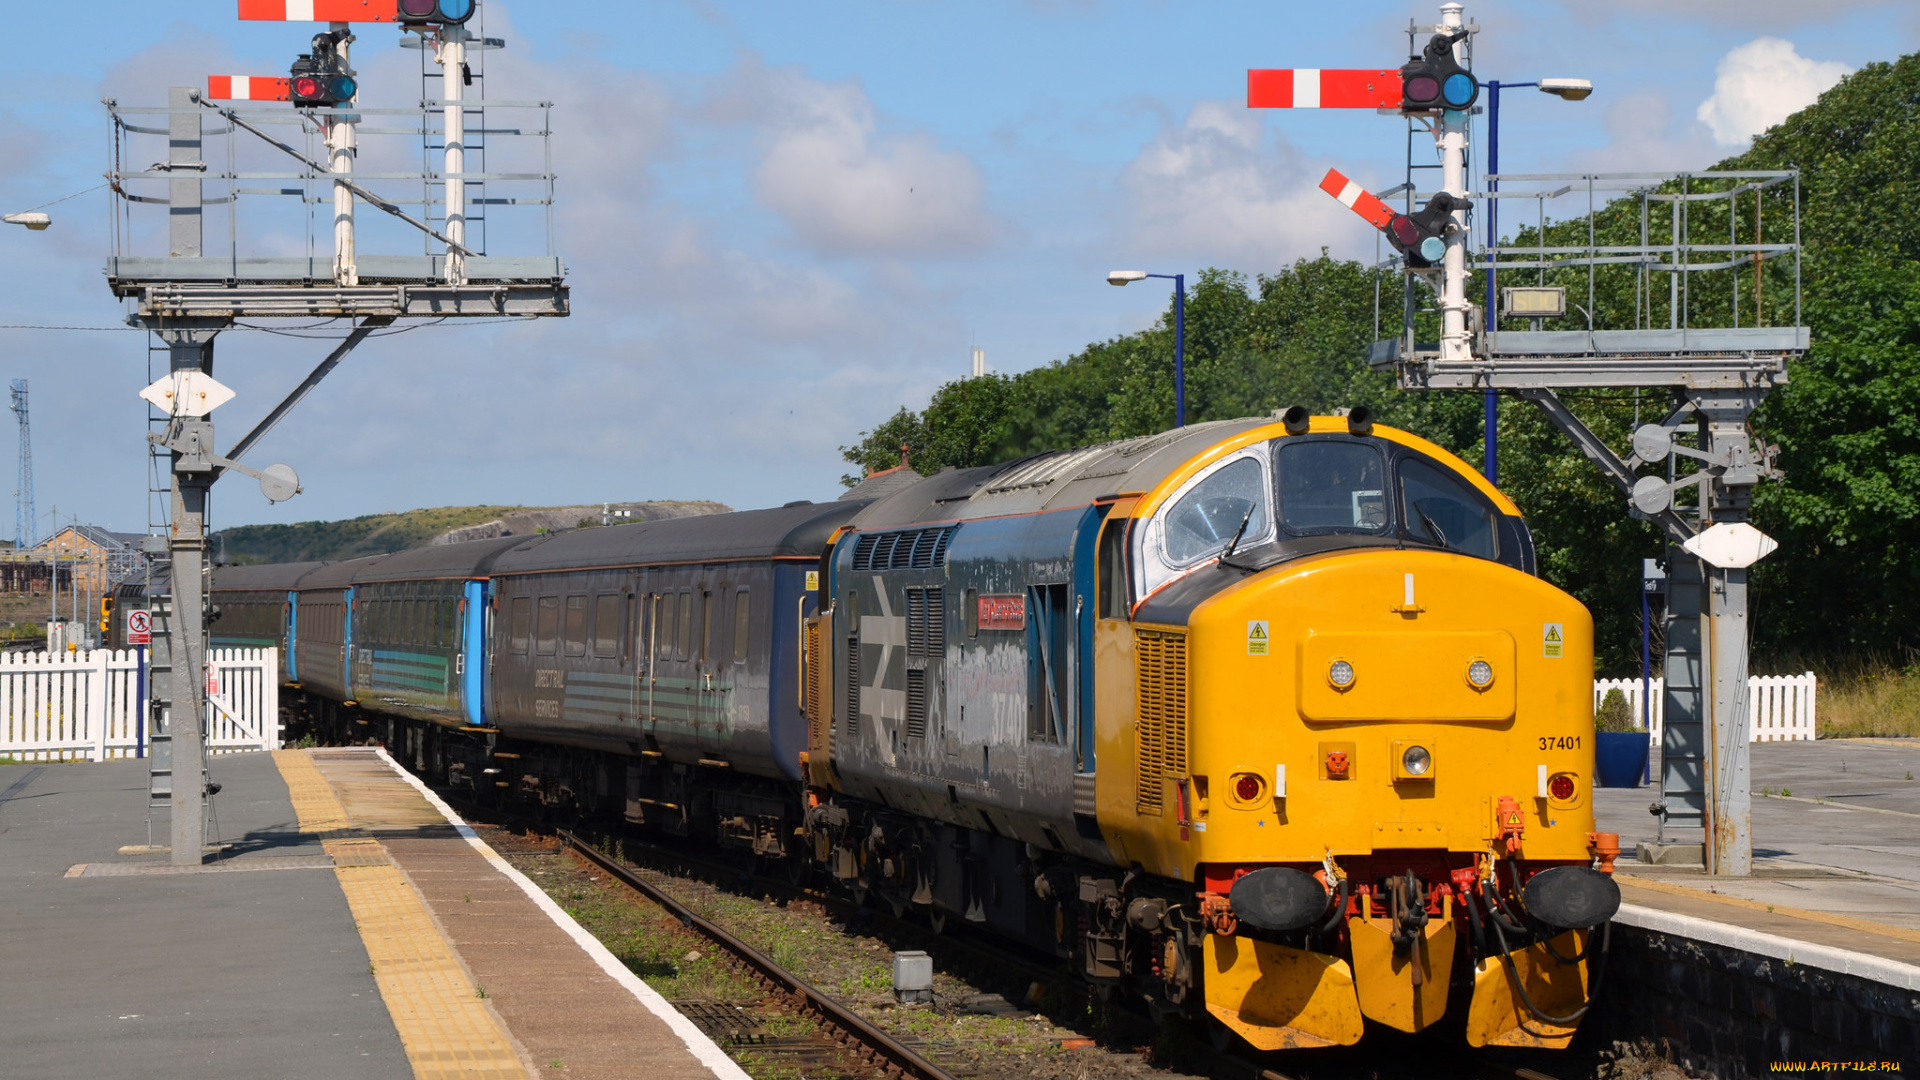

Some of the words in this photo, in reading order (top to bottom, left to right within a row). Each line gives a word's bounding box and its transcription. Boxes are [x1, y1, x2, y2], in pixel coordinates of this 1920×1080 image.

[535, 699, 559, 719] SERVICES
[992, 692, 1027, 747] 37401
[1539, 736, 1581, 751] 37401
